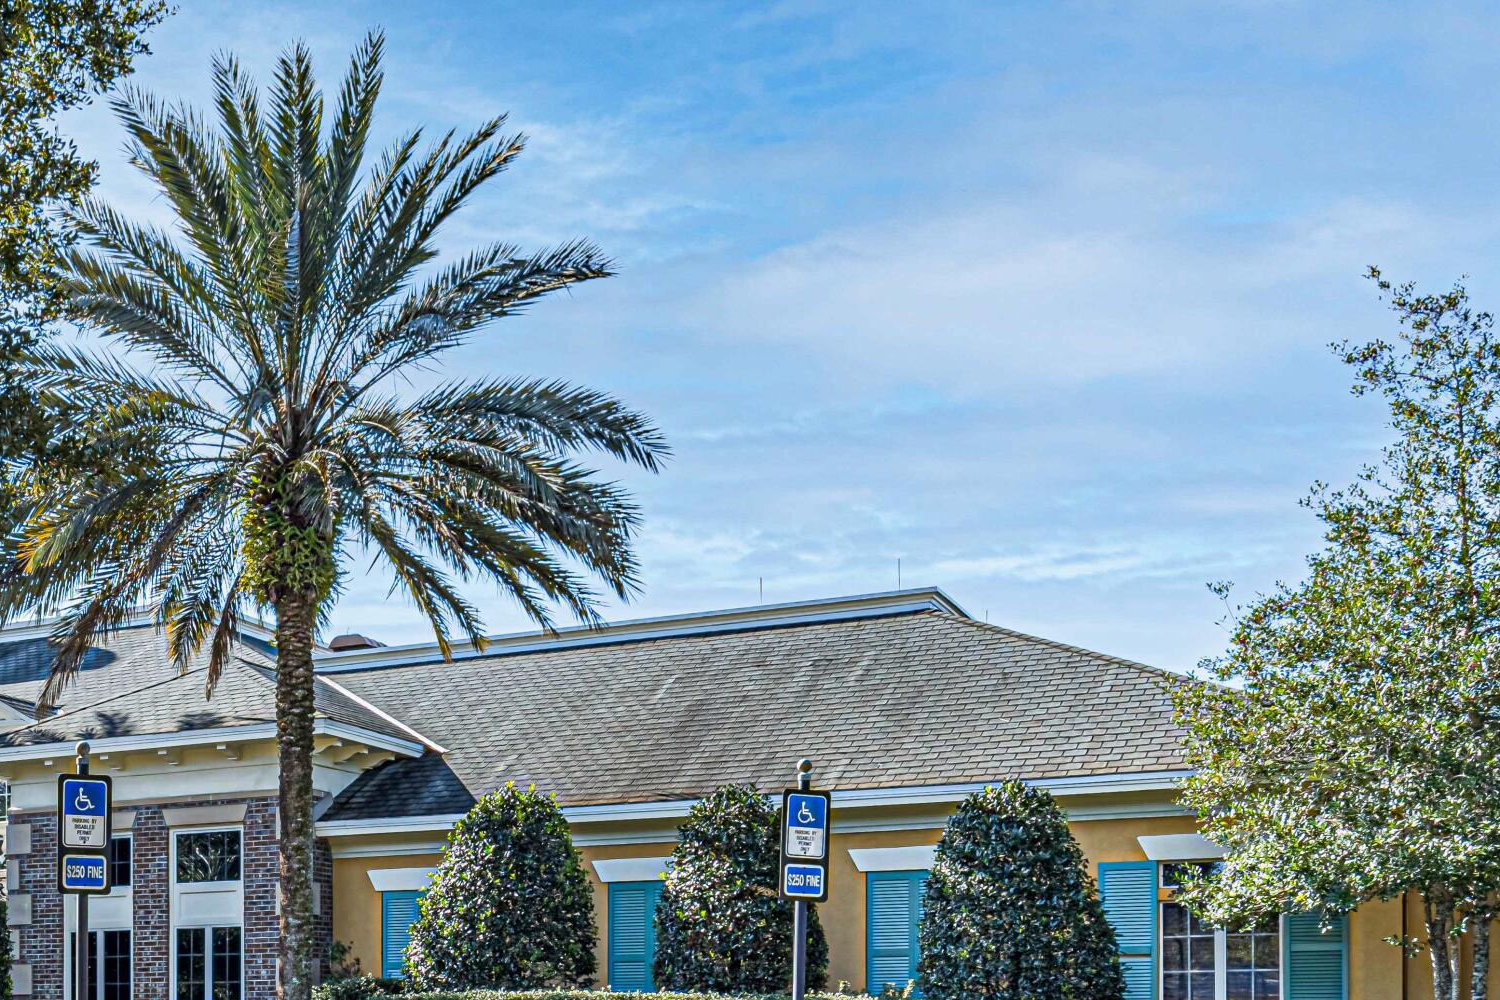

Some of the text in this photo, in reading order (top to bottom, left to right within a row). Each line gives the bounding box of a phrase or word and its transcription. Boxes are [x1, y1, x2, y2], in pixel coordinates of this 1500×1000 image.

[67, 864, 103, 879] $250 FINE
[787, 873, 820, 887] $250 FINE
